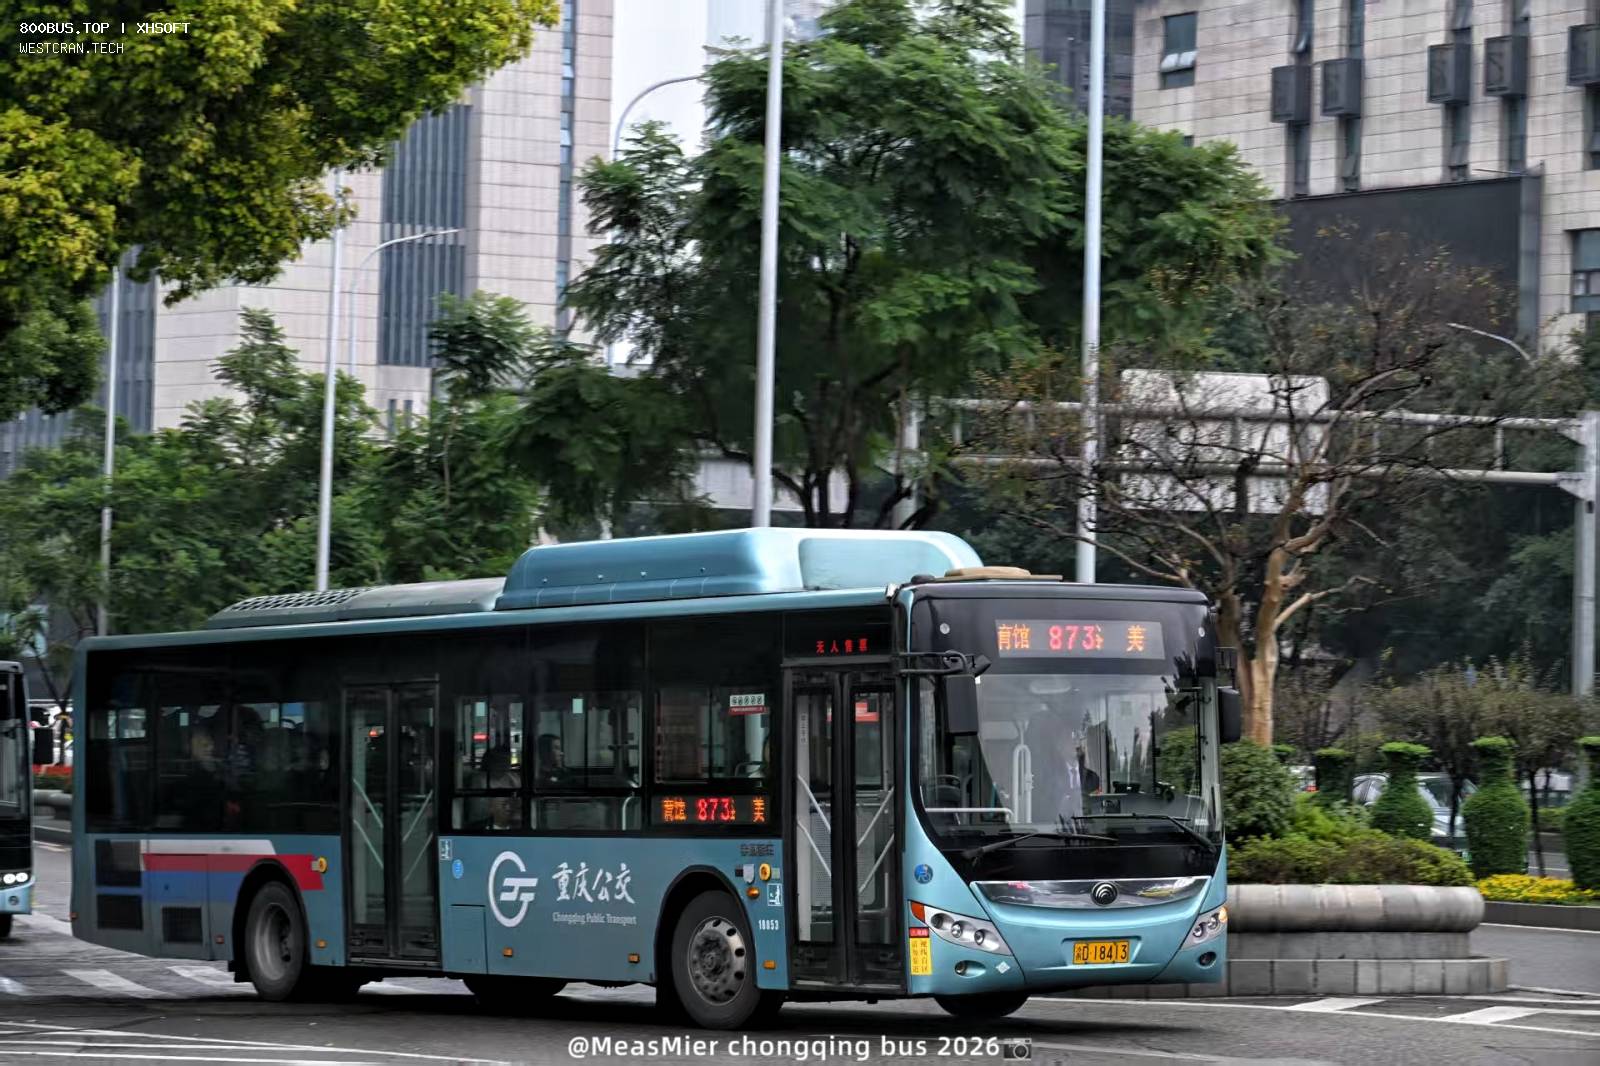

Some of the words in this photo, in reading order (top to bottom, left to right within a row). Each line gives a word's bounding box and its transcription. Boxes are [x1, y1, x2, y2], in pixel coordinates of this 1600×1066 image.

[1049, 624, 1097, 650] 873
[1127, 624, 1146, 652] 美
[697, 797, 731, 821] 873
[551, 861, 636, 904] 重庆公交
[586, 912, 606, 923] Public
[606, 913, 637, 926] Transport
